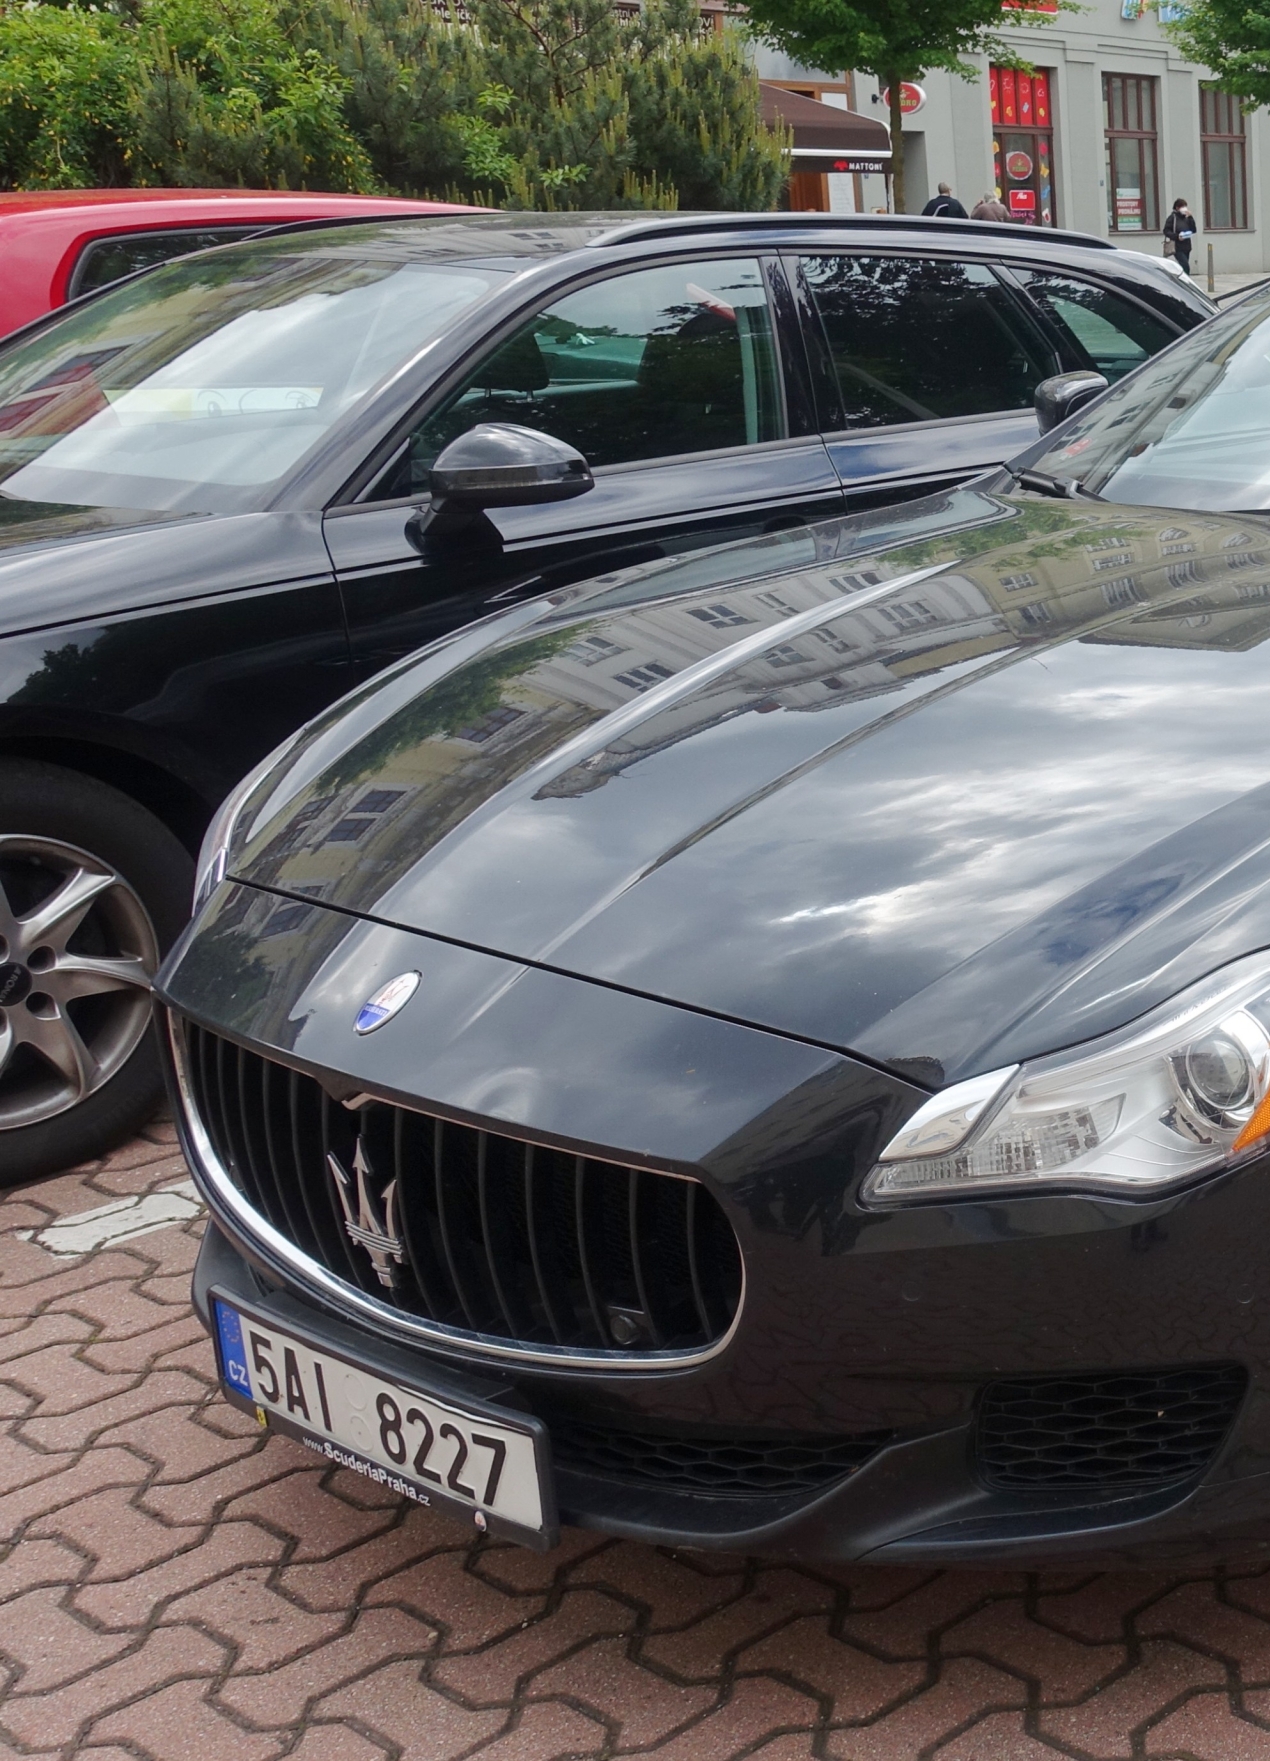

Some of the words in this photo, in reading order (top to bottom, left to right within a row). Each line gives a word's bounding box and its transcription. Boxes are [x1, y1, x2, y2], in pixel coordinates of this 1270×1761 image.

[228, 1359, 248, 1387] CZ
[303, 1436, 431, 1507] www.ScuderiaPraha.cz
[375, 1392, 506, 1506] 8227
